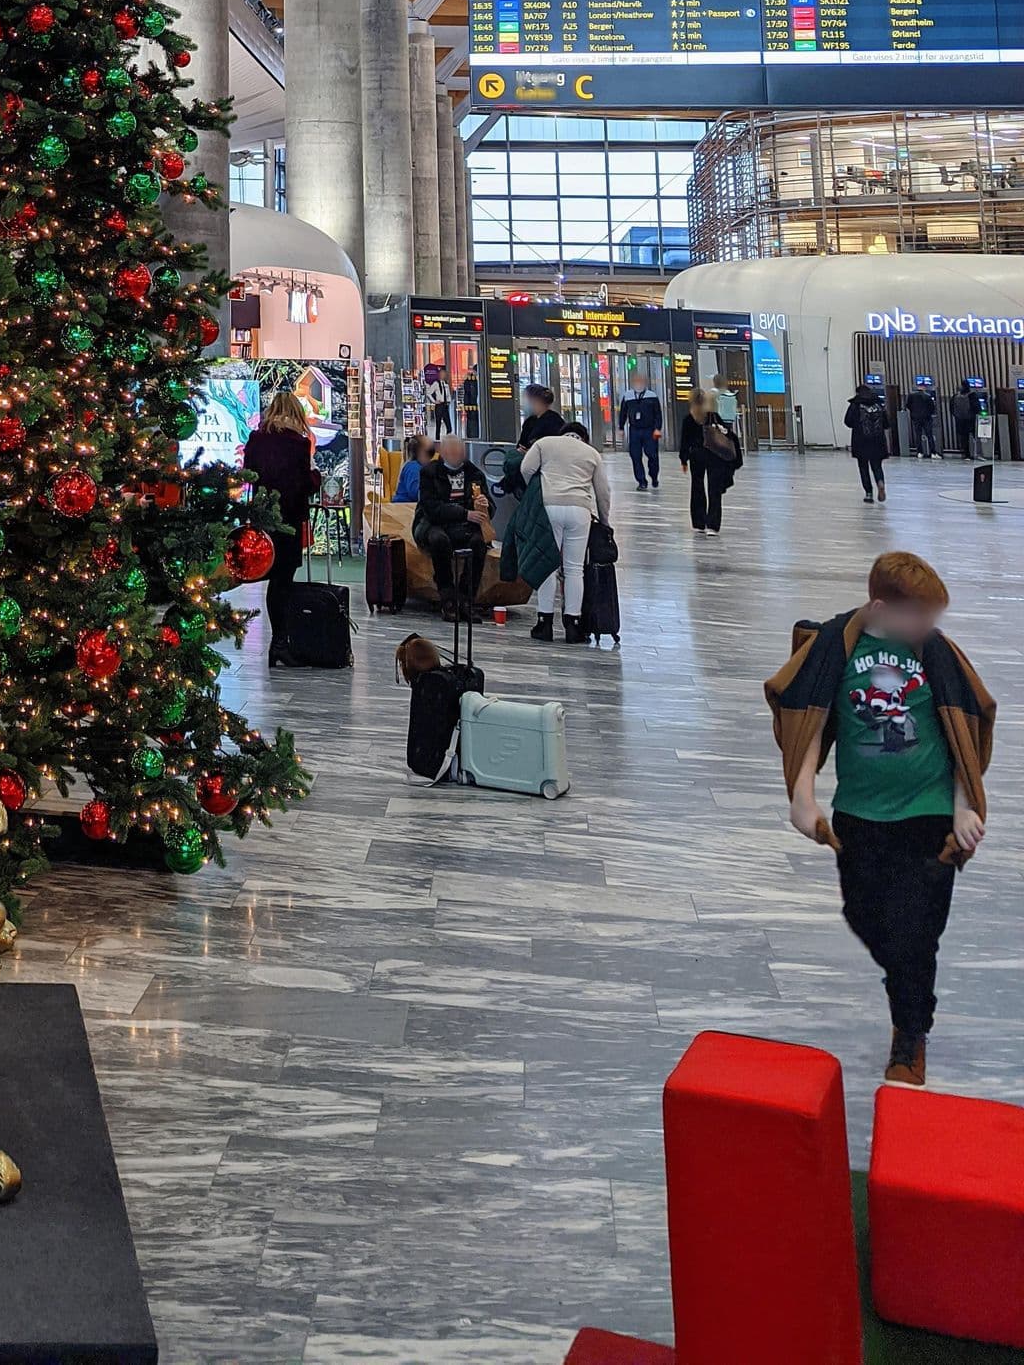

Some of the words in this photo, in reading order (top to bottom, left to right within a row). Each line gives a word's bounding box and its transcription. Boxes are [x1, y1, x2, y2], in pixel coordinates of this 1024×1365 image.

[889, 8, 919, 17] Bergen
[575, 75, 594, 99] C
[562, 309, 583, 319] Utland
[585, 310, 624, 321] International
[868, 308, 915, 338] DNB
[930, 314, 1024, 339] Exchang
